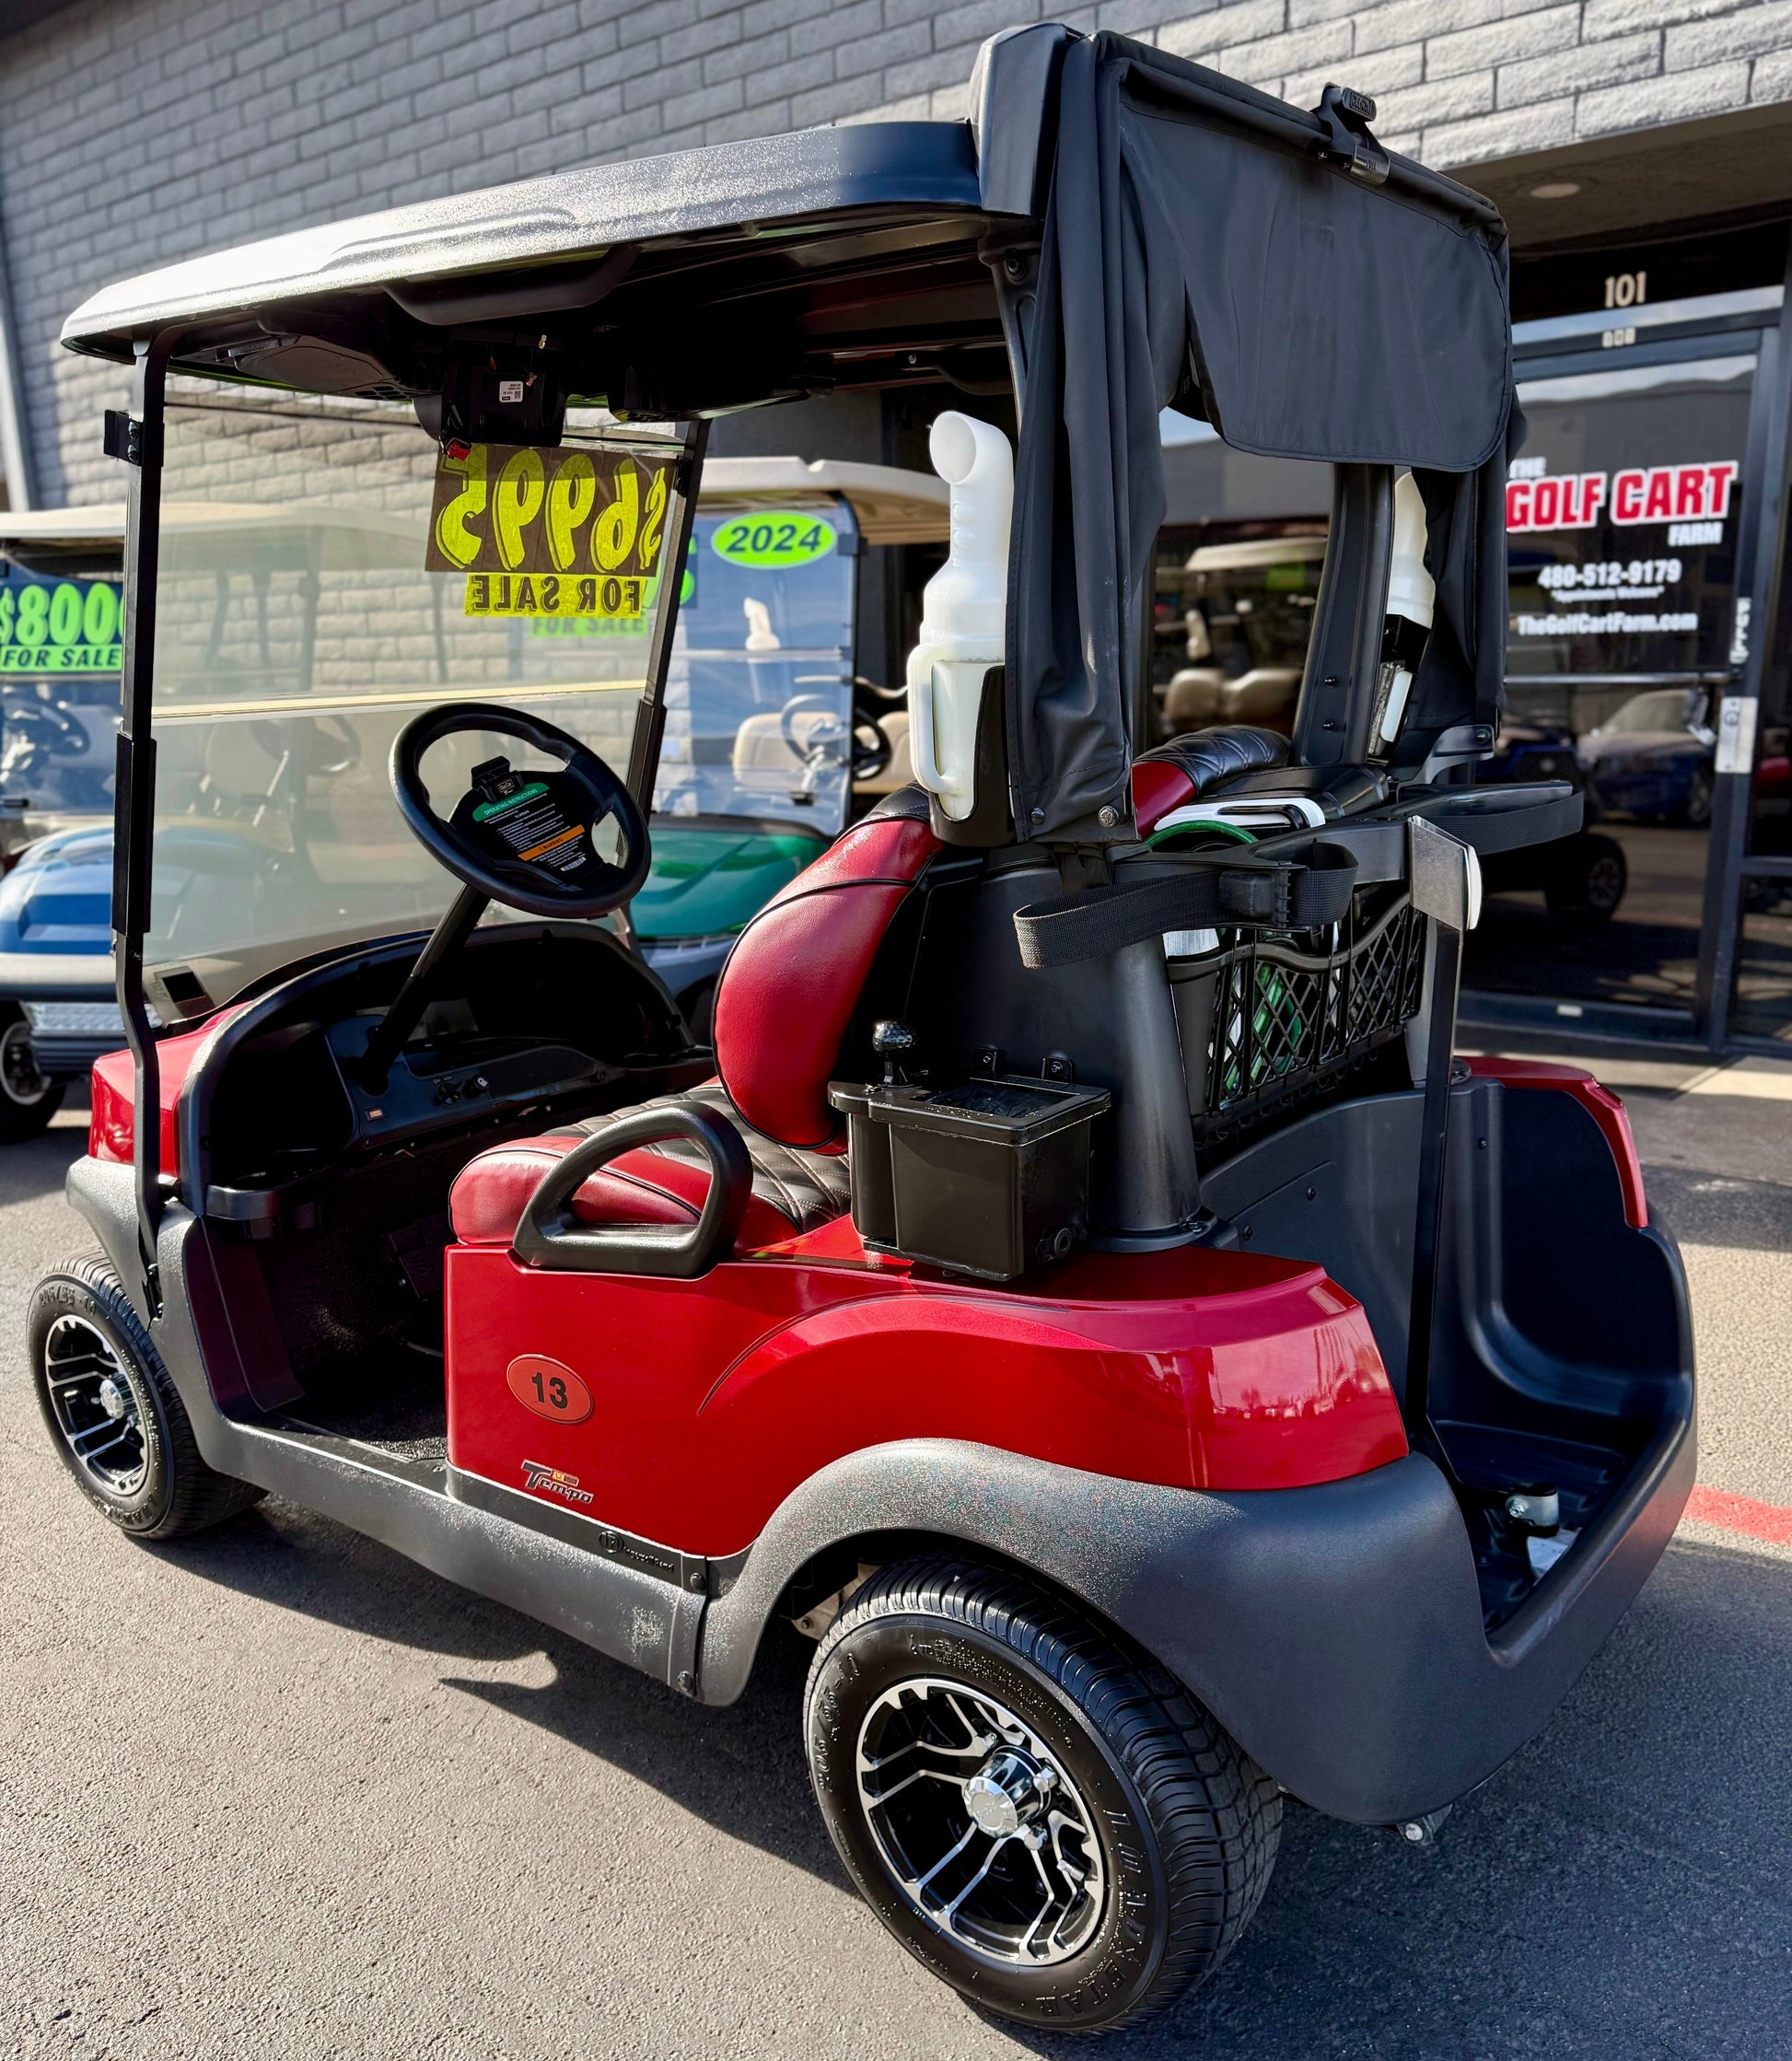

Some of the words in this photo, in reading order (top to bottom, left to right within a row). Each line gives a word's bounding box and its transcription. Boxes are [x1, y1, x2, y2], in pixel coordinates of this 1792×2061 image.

[1604, 271, 1647, 308] 101
[1509, 456, 1546, 479] THE
[1506, 472, 1607, 532] GOLF
[1611, 460, 1739, 526] CART
[726, 524, 821, 553] 2024
[1668, 521, 1723, 546] FARM
[1537, 558, 1681, 588] 480-512-9179
[0, 582, 124, 646] $800
[587, 611, 646, 634] SALE
[1518, 612, 1698, 635] TheGolfCartFarm.com
[4, 648, 50, 667] FOR
[61, 647, 121, 667] SALE
[531, 1371, 568, 1409] 13
[521, 1459, 594, 1504] Tempo
